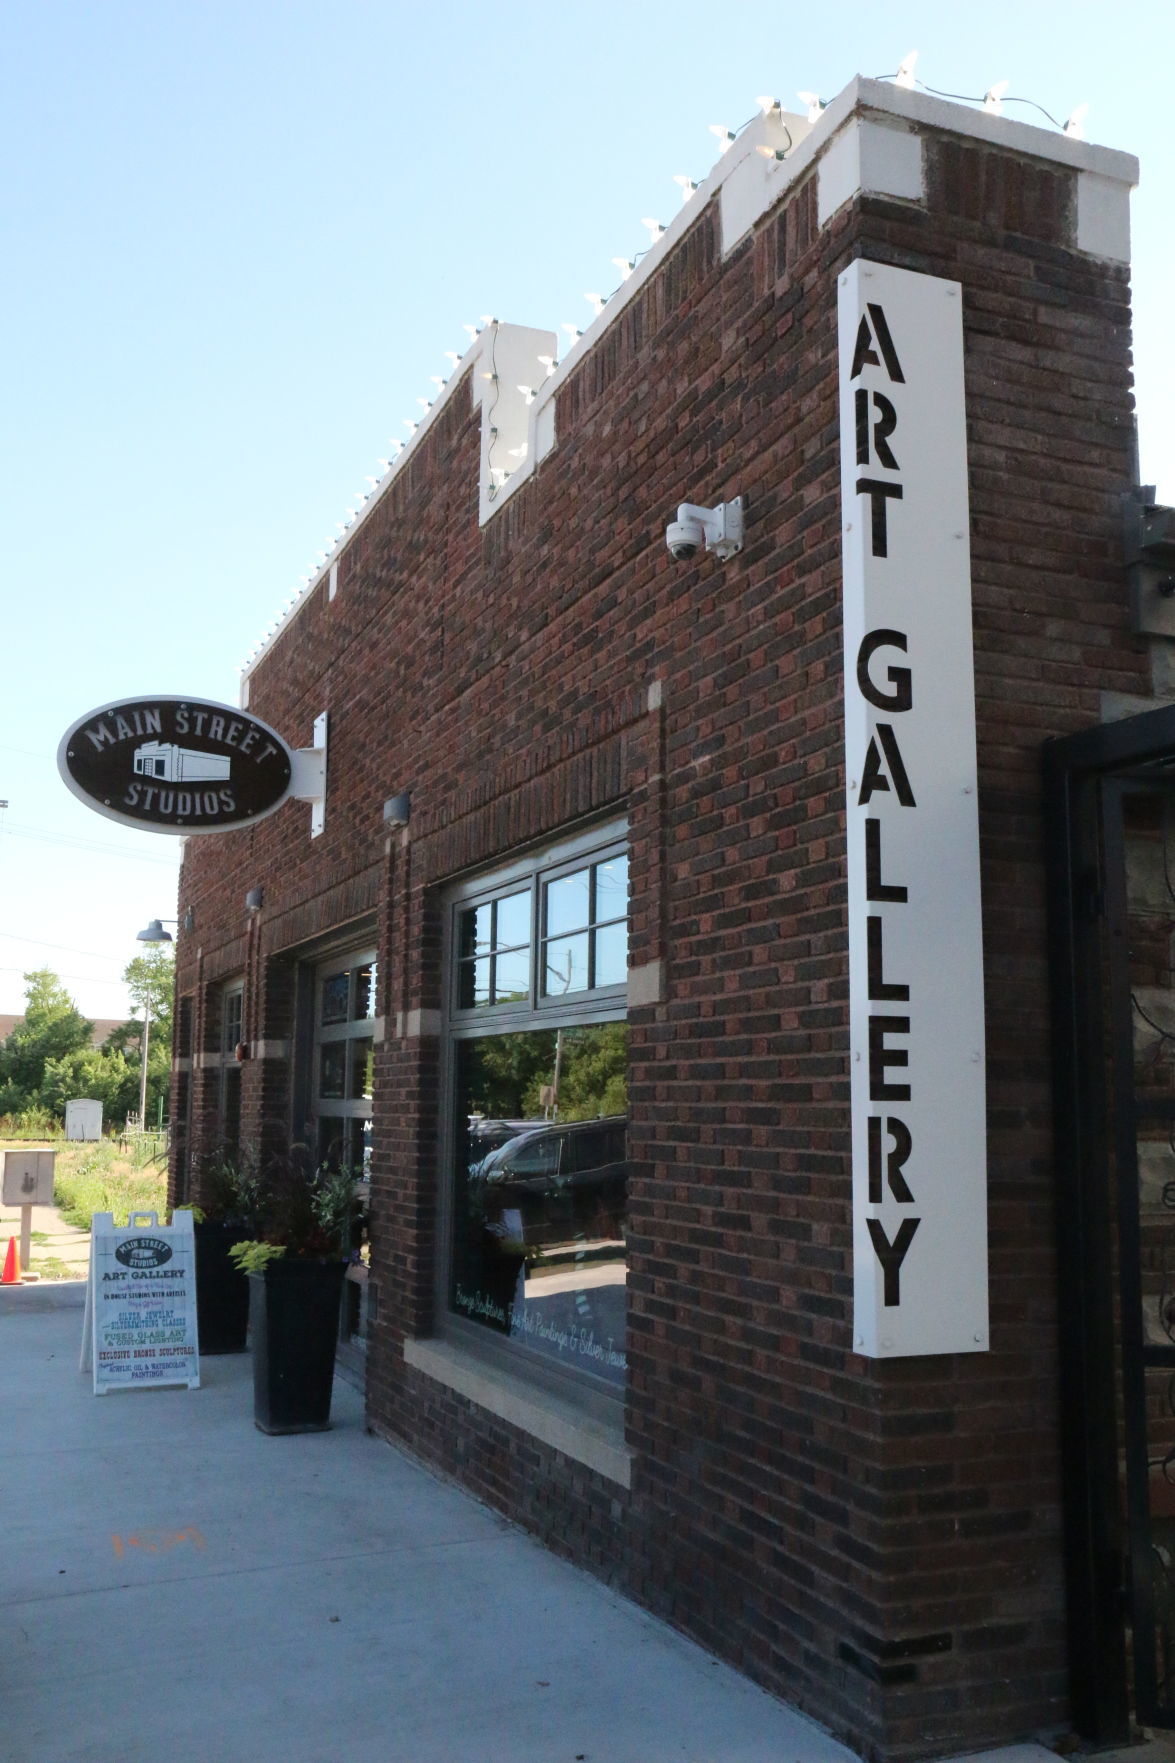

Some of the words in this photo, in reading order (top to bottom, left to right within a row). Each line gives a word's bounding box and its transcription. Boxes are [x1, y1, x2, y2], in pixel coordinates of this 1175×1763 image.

[850, 302, 906, 558] ART
[84, 709, 162, 751] MAIN
[176, 709, 277, 764] STREET
[125, 782, 236, 816] STUDIOS
[857, 628, 921, 1307] GALLERY
[119, 1240, 139, 1254] MAIN
[141, 1239, 169, 1252] STREET
[129, 1258, 158, 1267] STUDIOS
[103, 1272, 127, 1280] ART
[131, 1269, 186, 1280] GALLERY
[119, 1312, 140, 1320] SILVER
[162, 1317, 186, 1327] CLASSES
[104, 1333, 134, 1341] FUSED
[138, 1330, 165, 1339] GLASS
[169, 1329, 187, 1338] ART
[99, 1350, 130, 1360] EXCLUSIVE
[133, 1349, 156, 1358] BRONZE
[159, 1346, 195, 1357] SCULPTURES
[151, 1361, 186, 1370] WATERCOLOR
[132, 1370, 164, 1379] PAINTINGS
